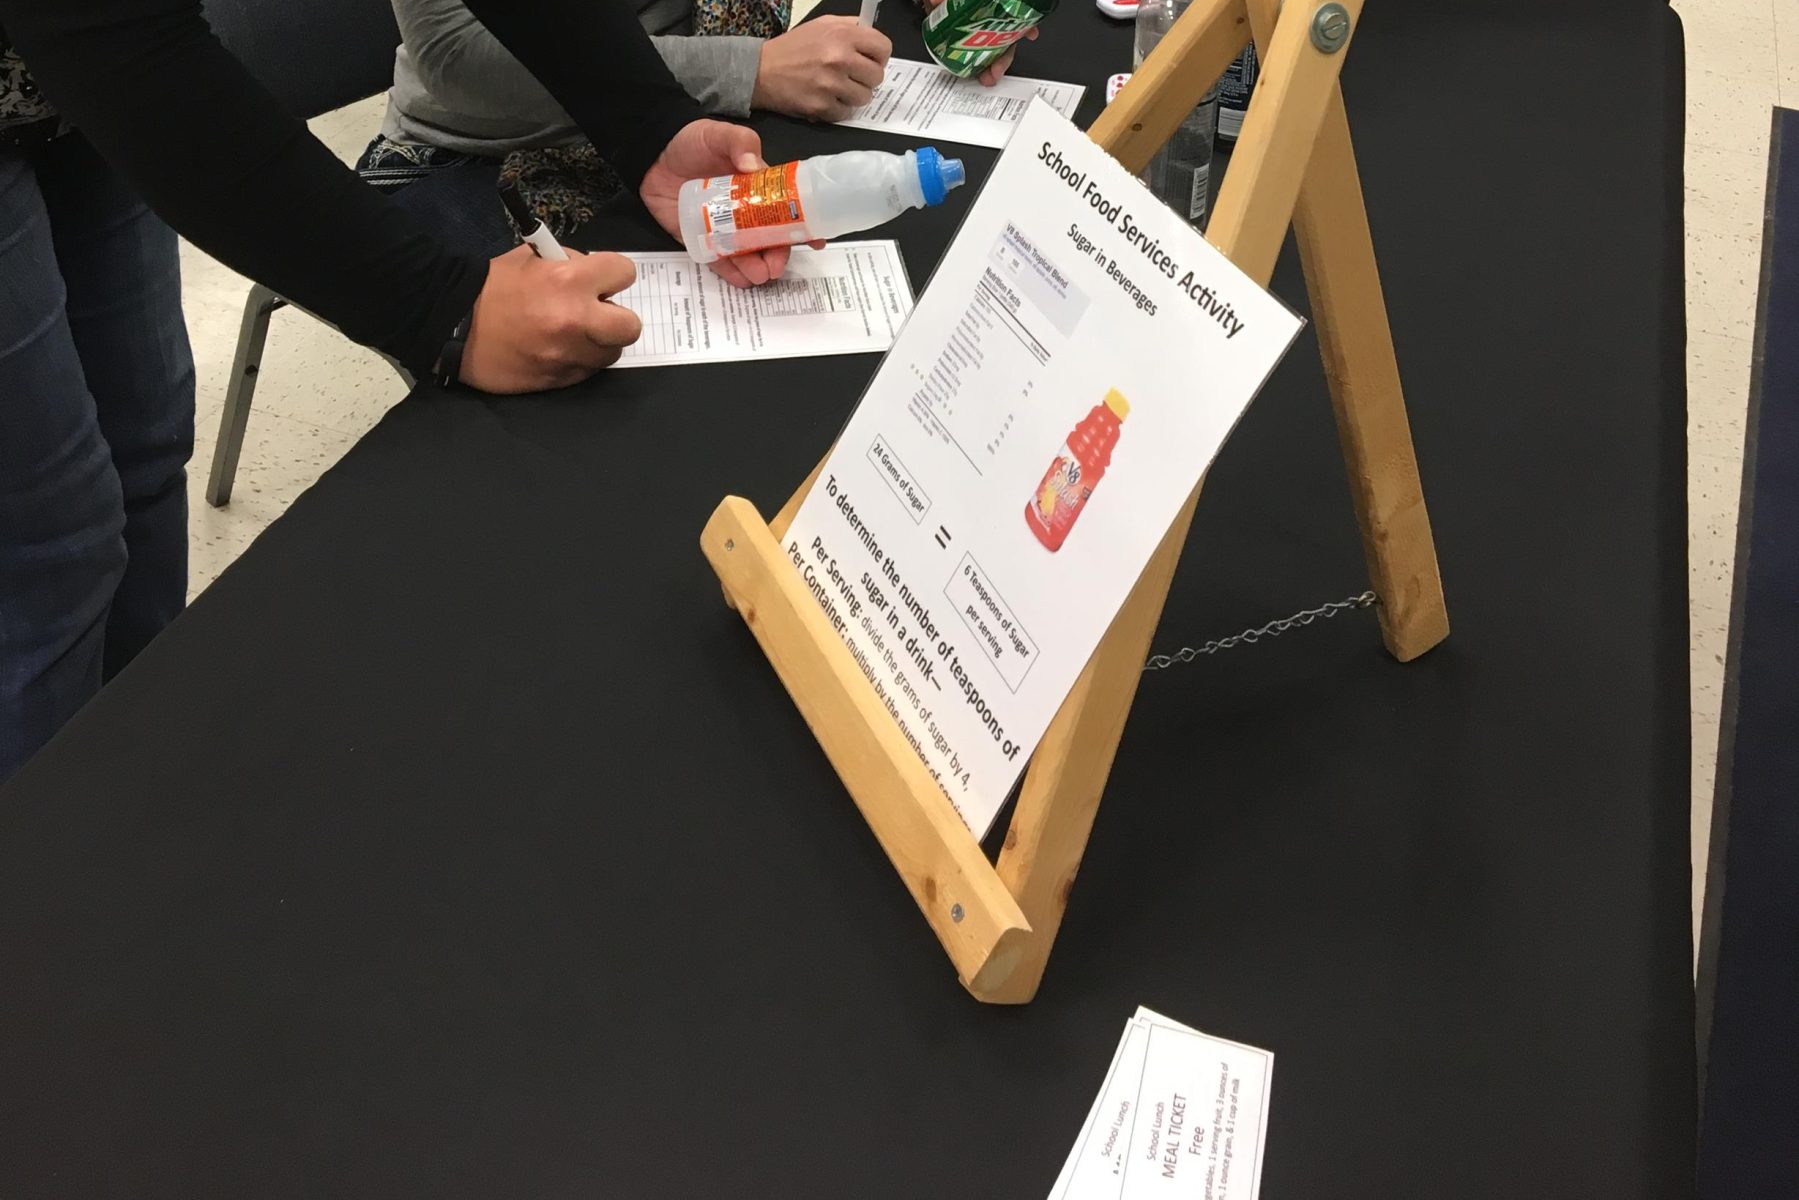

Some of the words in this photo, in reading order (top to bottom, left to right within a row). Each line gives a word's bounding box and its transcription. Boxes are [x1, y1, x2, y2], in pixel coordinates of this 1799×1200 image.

[1005, 223, 1015, 234] V8
[1013, 230, 1032, 253] Splash
[1031, 247, 1053, 275] Tropical
[1051, 269, 1069, 289] Blend
[1037, 141, 1087, 192] School
[1082, 181, 1123, 224] Food
[1117, 214, 1179, 279] Services
[1177, 270, 1245, 340] Activity
[985, 267, 1008, 292] Nutrition
[1006, 286, 1022, 308] Facts
[1067, 223, 1096, 257] Sugar
[1095, 248, 1107, 267] in
[1106, 260, 1158, 317] Beverages
[873, 443, 884, 457] 24
[881, 453, 901, 482] Grams
[899, 479, 909, 491] of
[906, 486, 925, 512] Sugar
[825, 474, 838, 497] To
[836, 494, 884, 563] determine
[882, 557, 900, 588] the
[899, 584, 940, 643] number
[938, 641, 955, 662] of
[949, 657, 1004, 741] teaspoons
[1002, 739, 1021, 762] of
[861, 572, 889, 612] sugar
[886, 606, 899, 629] in
[898, 626, 907, 641] a
[964, 565, 971, 576] 6
[969, 572, 1003, 622] Teaspoons
[1001, 619, 1012, 632] of
[1009, 628, 1030, 659] Sugar
[788, 541, 805, 569] Per
[803, 564, 849, 639] Container:
[846, 637, 877, 684] multiply
[875, 679, 886, 698] by
[884, 696, 900, 720] the
[965, 604, 981, 623] per
[978, 619, 1004, 659] serving
[812, 536, 829, 564] Per
[826, 559, 864, 619] Serving:
[861, 616, 885, 652] divide
[883, 648, 899, 673] the
[895, 671, 921, 710] grams
[919, 708, 932, 724] of
[928, 721, 952, 757] sugar
[950, 752, 965, 775] by
[962, 772, 972, 791] 4,
[1219, 1072, 1228, 1099] ounces
[1221, 1061, 1229, 1072] of
[1231, 1078, 1241, 1094] milk
[1152, 1101, 1165, 1128] Lunch
[1168, 1093, 1187, 1136] TICKET
[1229, 1104, 1238, 1119] cup
[1230, 1093, 1238, 1104] of
[1101, 1126, 1119, 1157] School
[1113, 1100, 1131, 1127] Lunch
[1147, 1129, 1160, 1161] School
[1188, 1126, 1205, 1156] Free
[1211, 1126, 1222, 1155] serving
[1161, 1140, 1180, 1179] MEAL
[1220, 1158, 1230, 1184] ounce
